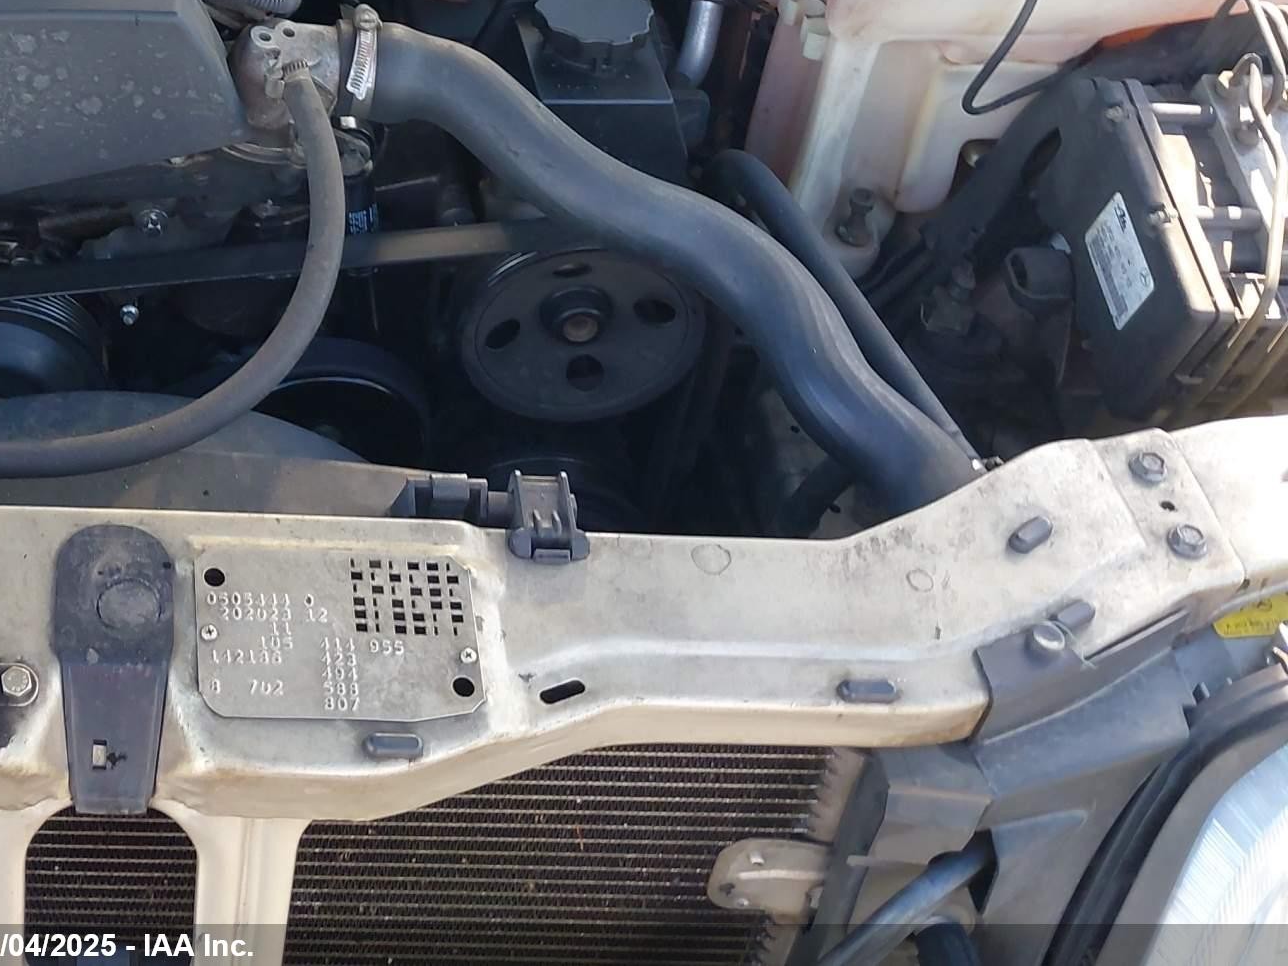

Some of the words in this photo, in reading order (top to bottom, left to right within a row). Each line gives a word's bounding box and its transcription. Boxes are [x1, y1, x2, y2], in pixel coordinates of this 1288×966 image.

[305, 607, 328, 623] 12
[369, 638, 405, 655] 955
[320, 651, 357, 667] 423
[324, 695, 361, 712] 807
